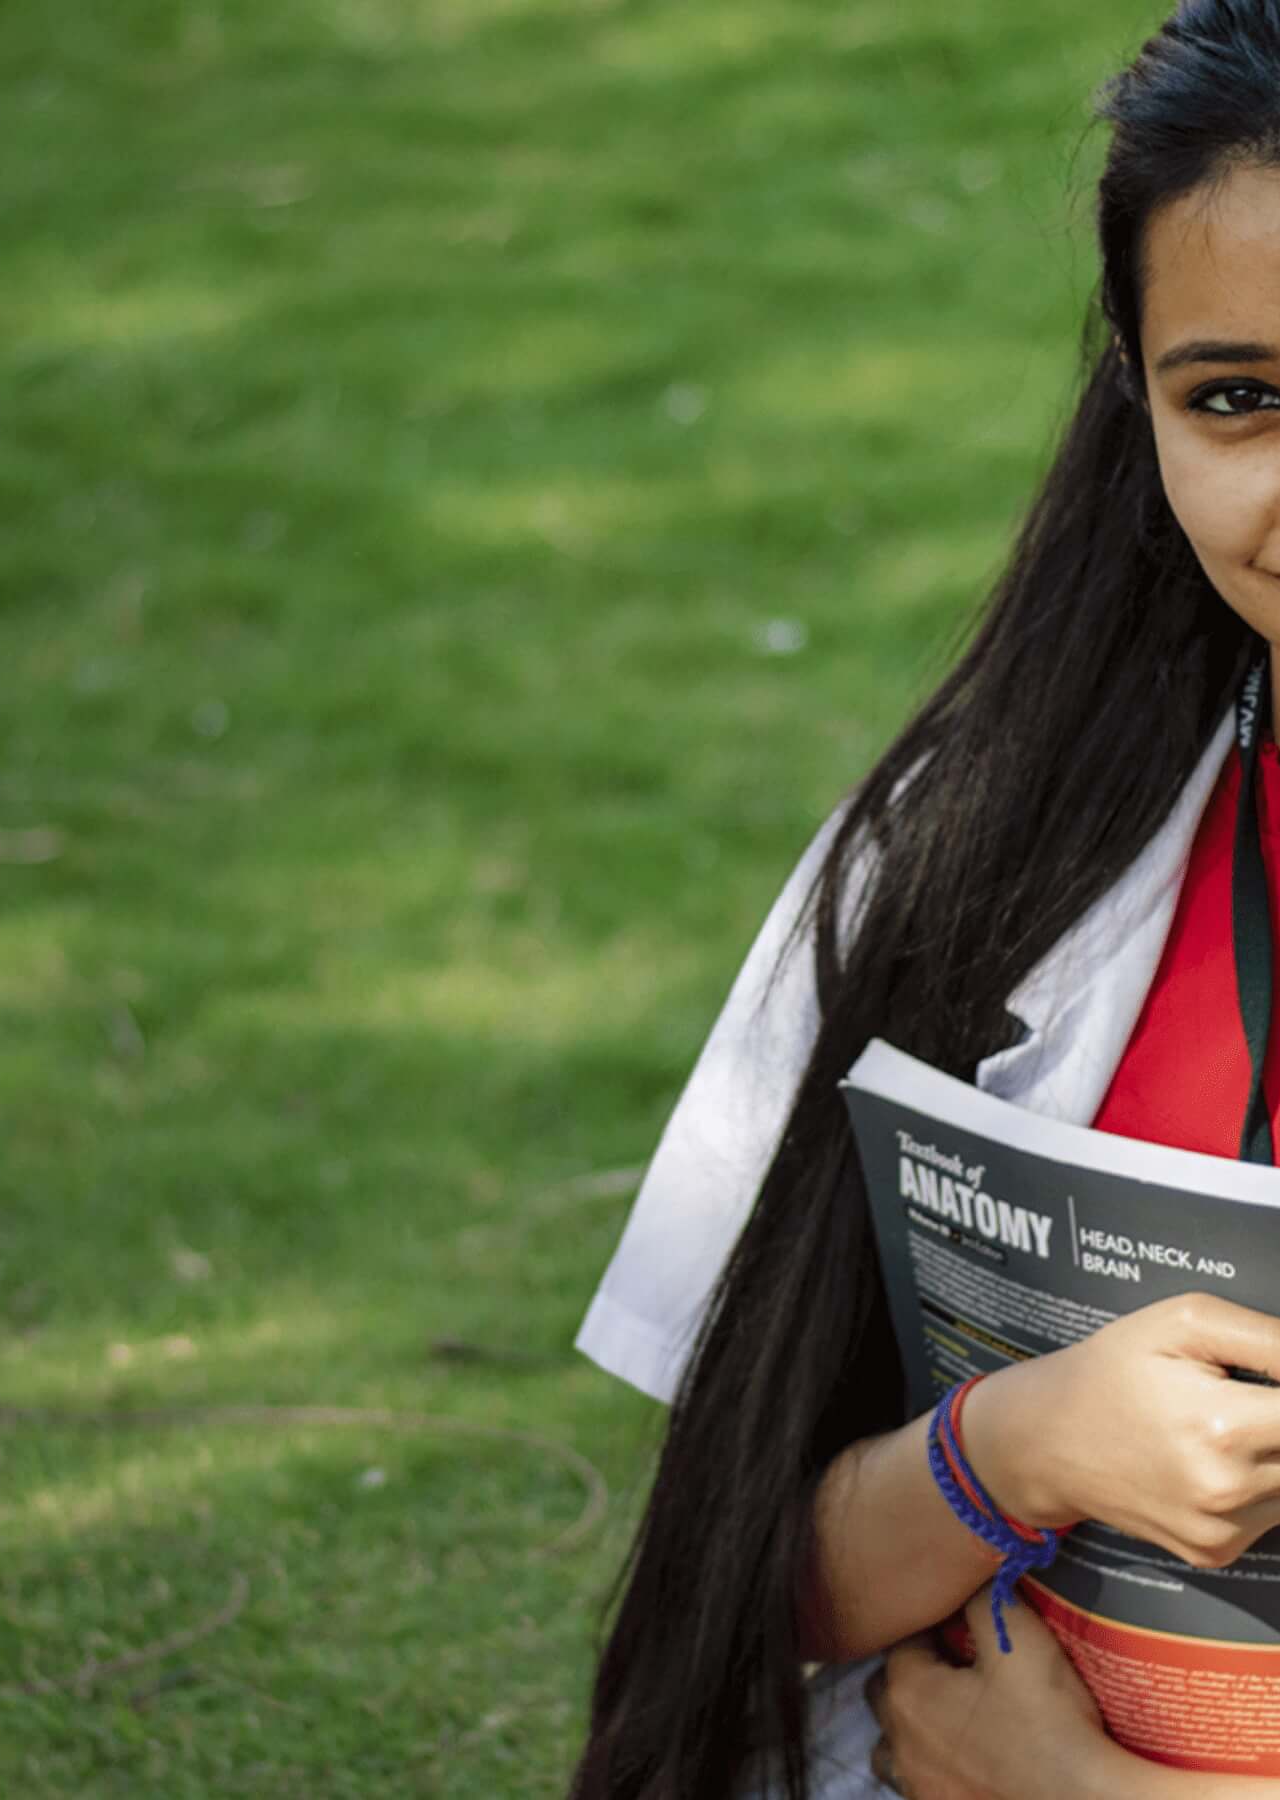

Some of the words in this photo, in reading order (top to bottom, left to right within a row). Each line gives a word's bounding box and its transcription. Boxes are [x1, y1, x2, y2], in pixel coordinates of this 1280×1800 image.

[895, 1129, 966, 1176] Textbook
[966, 1163, 987, 1190] of
[898, 1156, 1054, 1260] ANATOMY
[1079, 1227, 1136, 1259] HEAD,
[1137, 1239, 1191, 1270] NECK
[1196, 1255, 1236, 1279] AND
[1081, 1252, 1141, 1283] BRAIN
